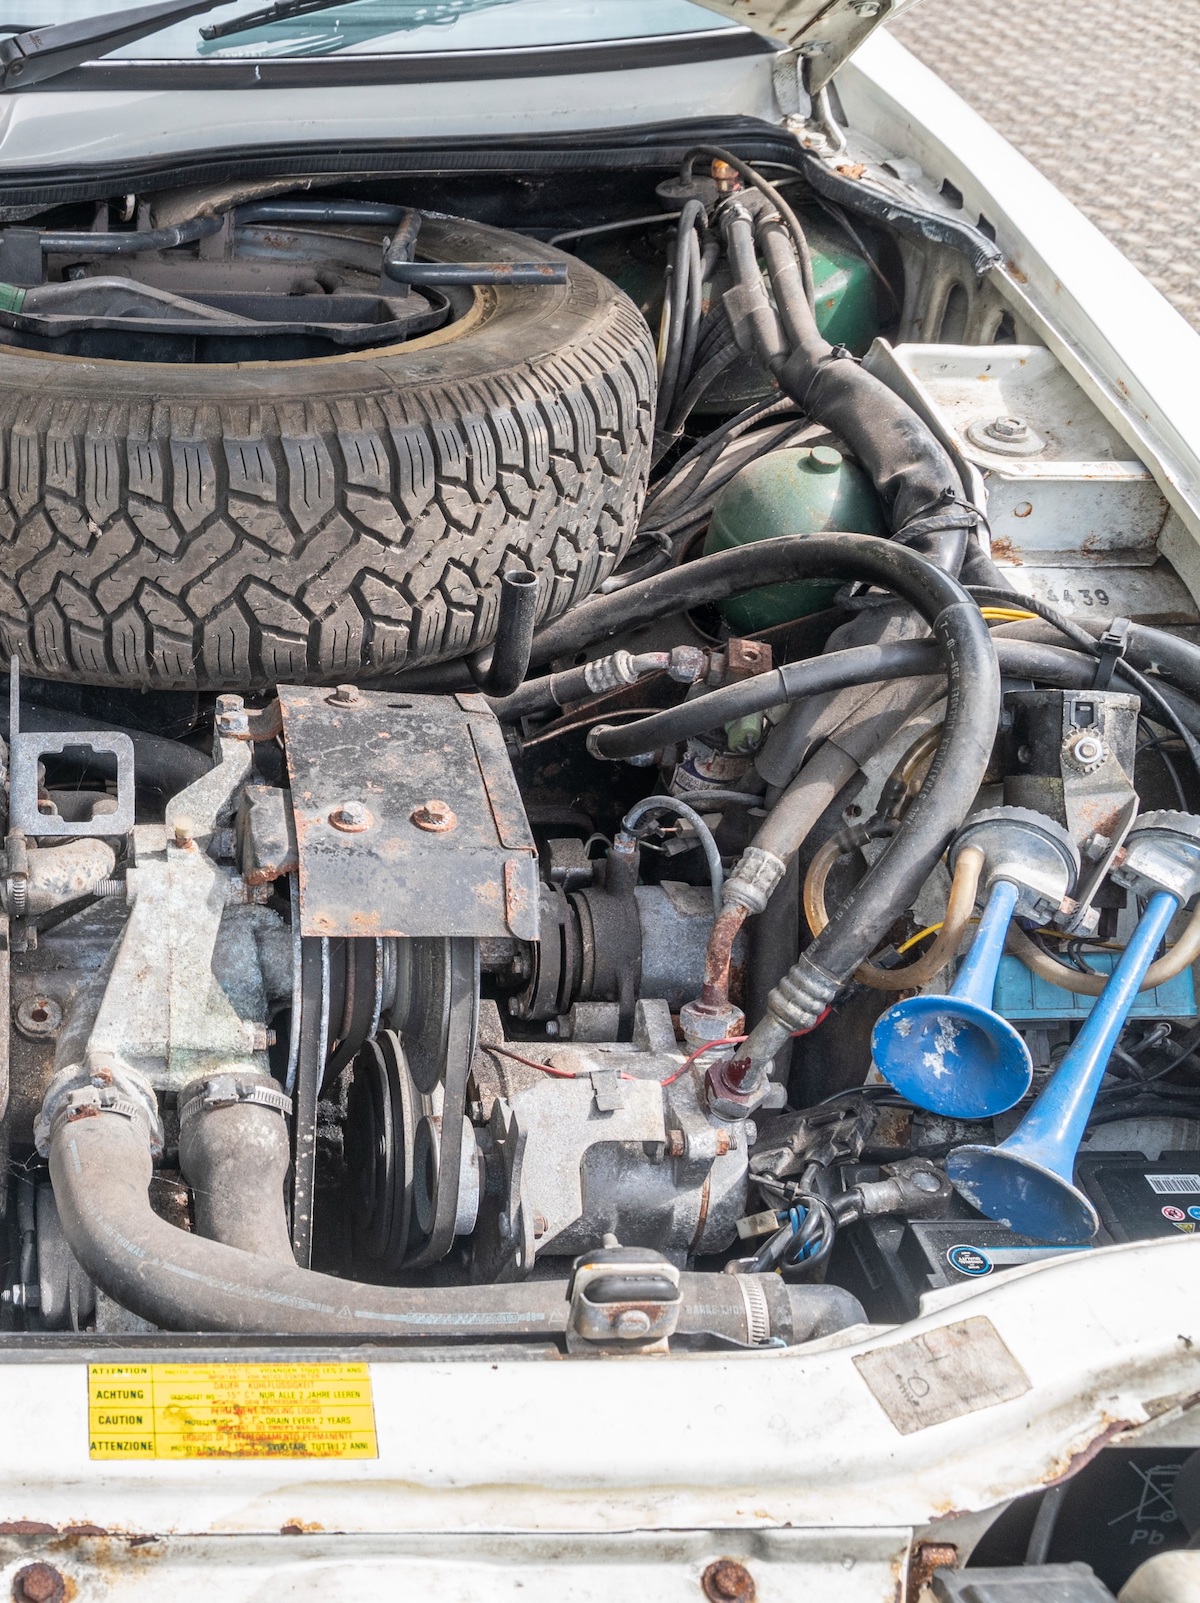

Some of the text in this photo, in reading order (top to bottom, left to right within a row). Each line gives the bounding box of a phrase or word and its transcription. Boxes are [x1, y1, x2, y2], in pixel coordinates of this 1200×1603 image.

[213, 1382, 239, 1390] DAUER
[96, 1390, 144, 1400] ACHTUNG
[259, 1391, 274, 1399] NUR
[98, 1416, 143, 1424] CAUTION
[182, 1433, 212, 1441] LIQUIDO
[302, 1432, 352, 1440] PERMANENTE
[90, 1442, 154, 1450] ATTENZIONE
[1129, 1529, 1166, 1545] Pb
